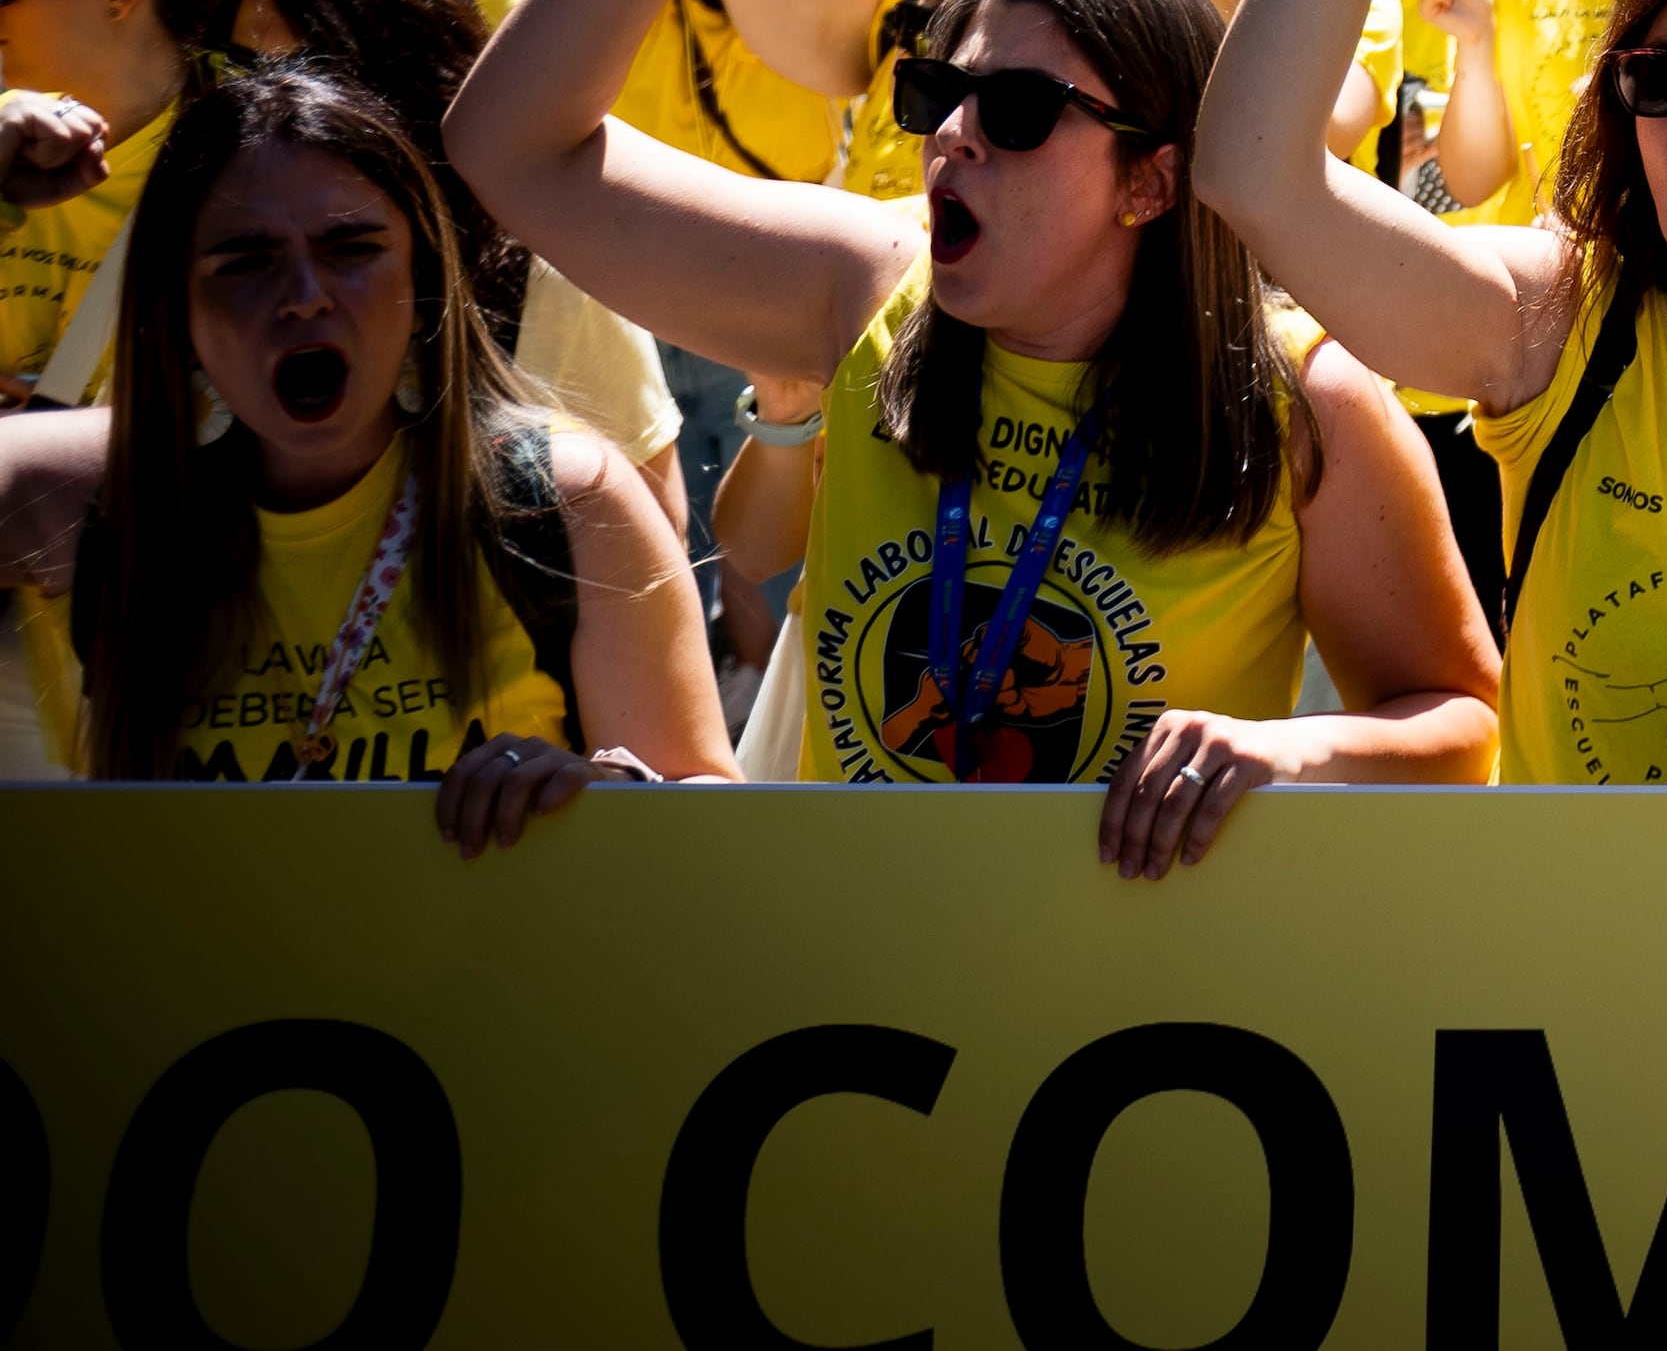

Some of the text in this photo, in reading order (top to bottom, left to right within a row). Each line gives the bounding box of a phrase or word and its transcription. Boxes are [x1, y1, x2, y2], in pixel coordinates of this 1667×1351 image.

[1597, 473, 1664, 515] SOMOS
[843, 515, 993, 606] LABOAL
[1052, 537, 1168, 688] ESCUELAS
[294, 635, 392, 677] VIA
[816, 606, 894, 784] ATAFORMA
[178, 716, 490, 782] MARILLA
[186, 690, 358, 730] EBERA
[1563, 675, 1613, 785] ESCUEL
